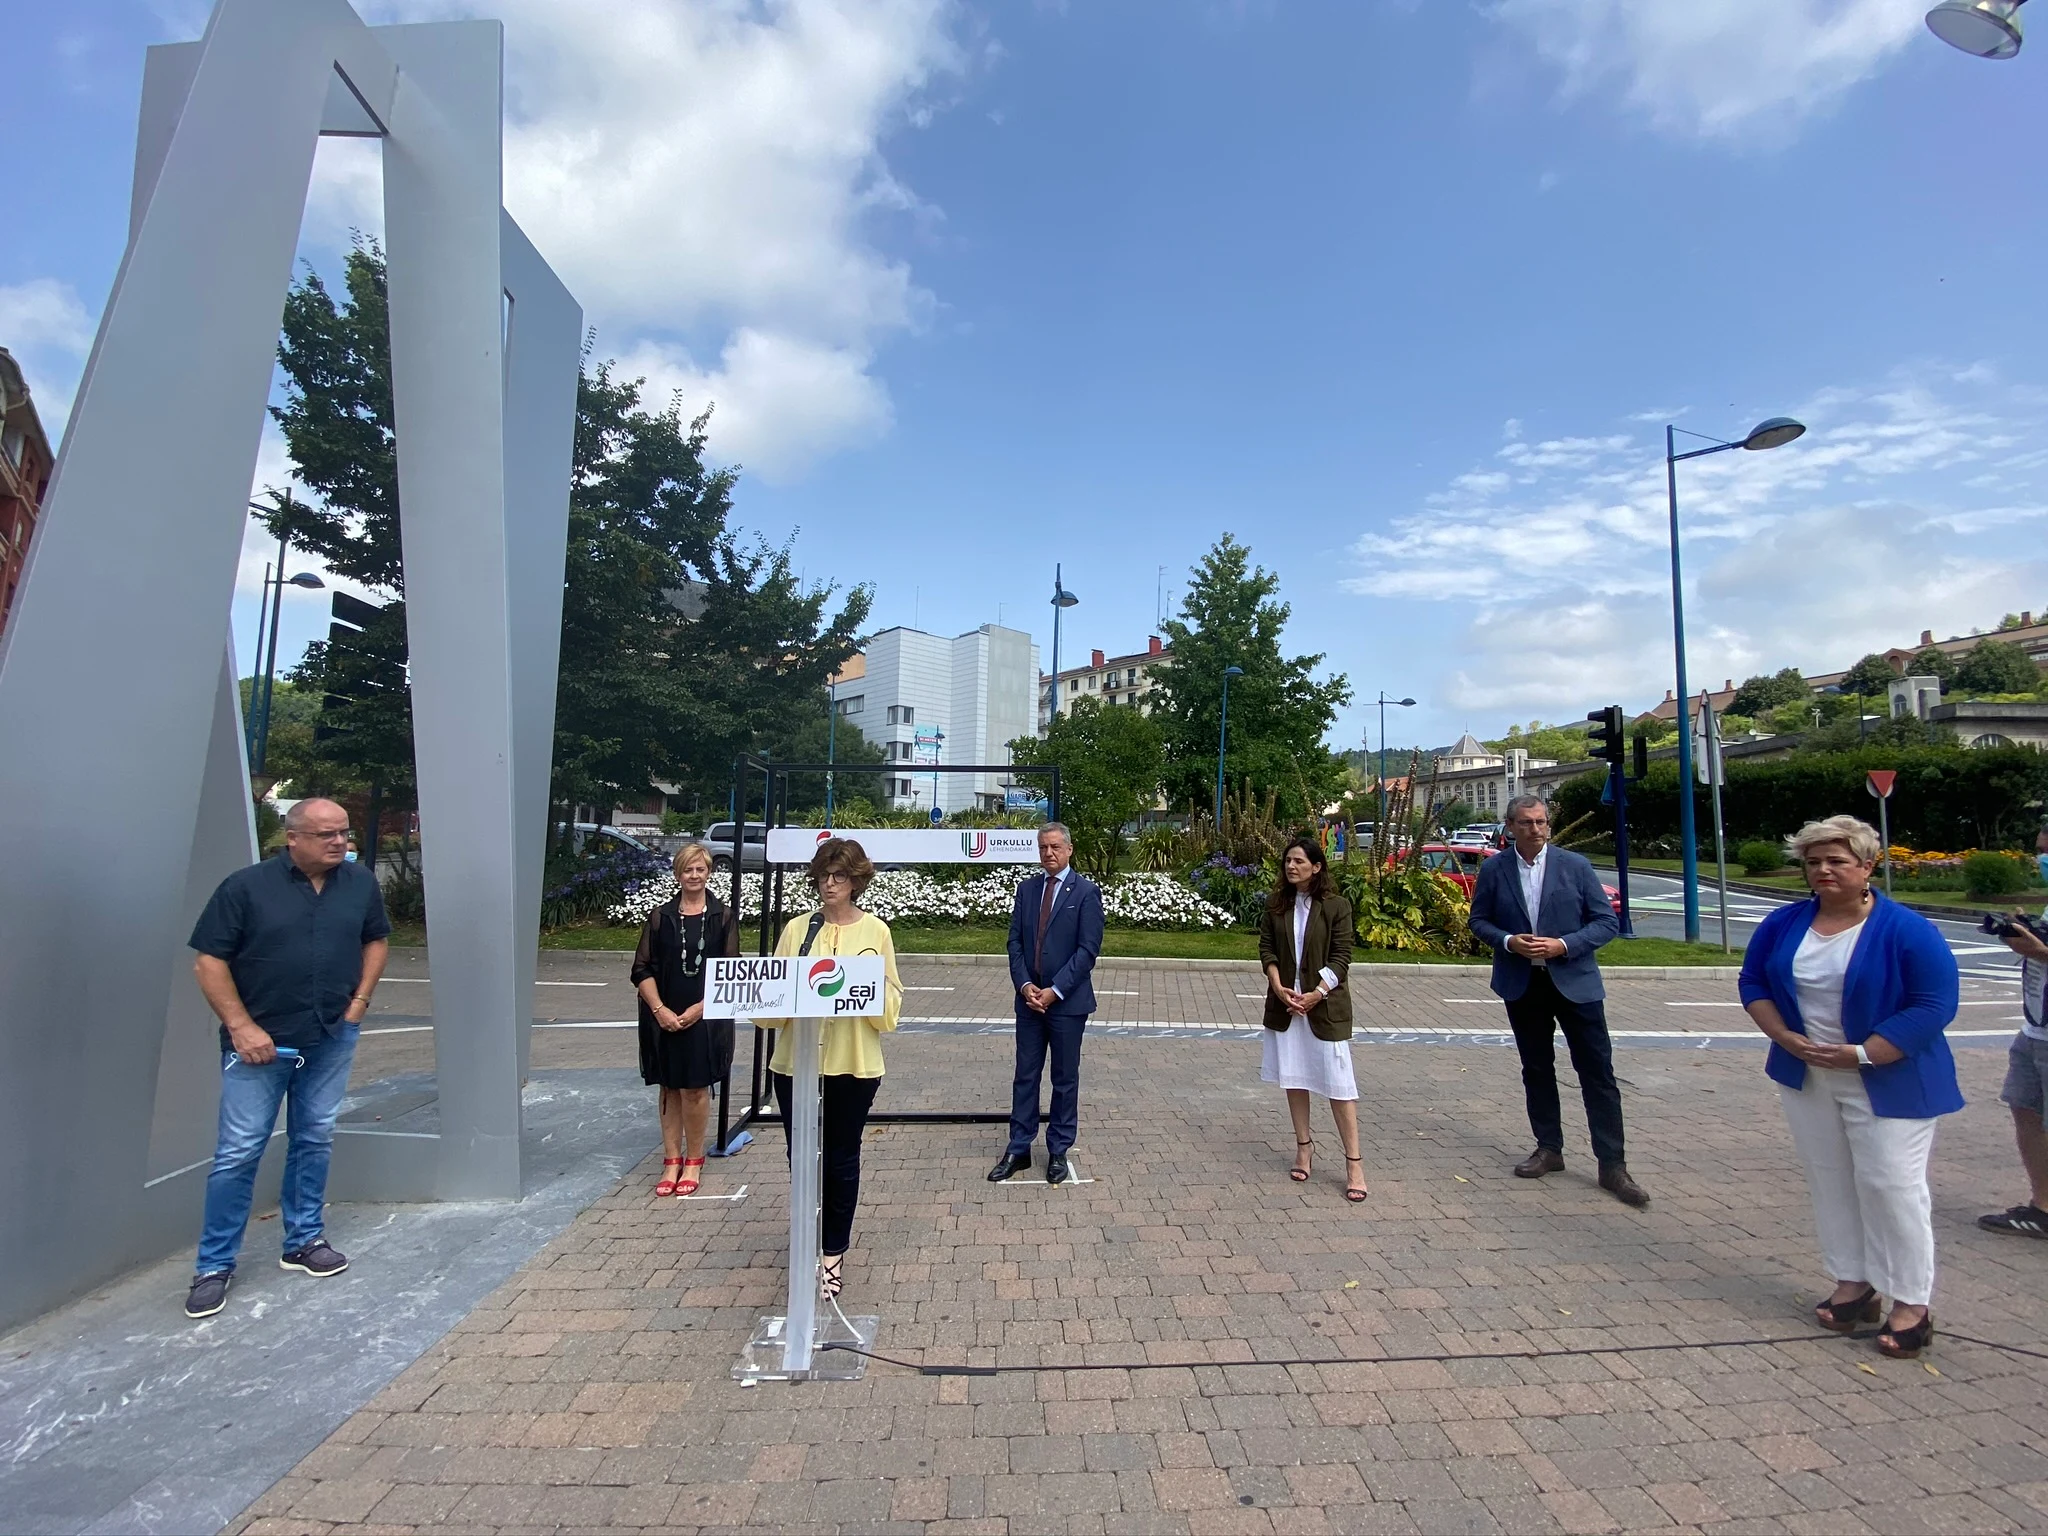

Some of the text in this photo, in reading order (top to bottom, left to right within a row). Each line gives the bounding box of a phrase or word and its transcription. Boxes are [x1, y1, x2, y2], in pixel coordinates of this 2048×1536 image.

[716, 959, 787, 981] EUSKADI
[713, 982, 763, 1003] ZUTIK
[849, 981, 876, 1001] eaj
[834, 998, 868, 1015] pnv
